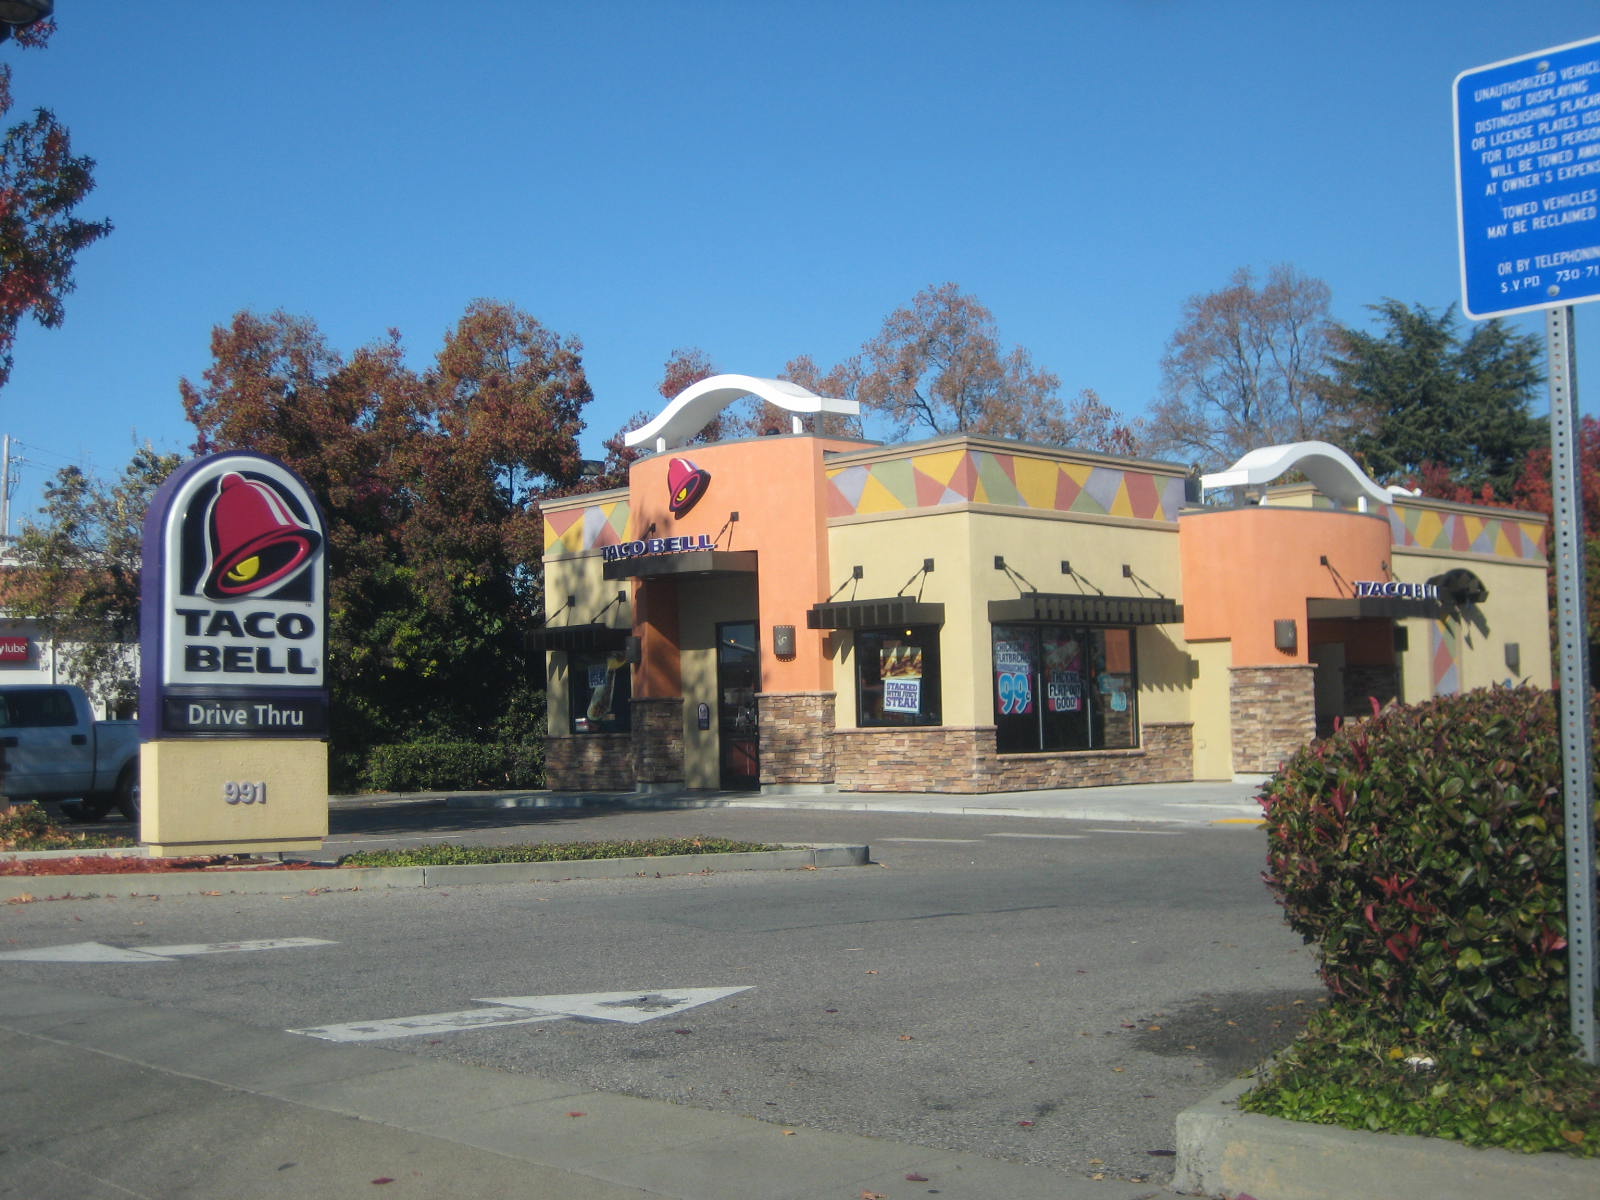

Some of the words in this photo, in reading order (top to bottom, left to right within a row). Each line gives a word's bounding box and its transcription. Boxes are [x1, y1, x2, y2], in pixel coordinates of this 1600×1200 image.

[1474, 71, 1556, 102] UNAUTHORIZED
[1501, 96, 1522, 112] NOT
[1525, 80, 1589, 106] DISPLAYING
[1471, 137, 1487, 151] OR
[1490, 125, 1534, 147] LICENSE
[1537, 115, 1578, 136] PLATES
[1475, 104, 1556, 134] DISTINGUISHING
[1482, 149, 1502, 165] FOR
[1506, 136, 1557, 160] DISABLED
[1490, 164, 1514, 178] WILL
[1518, 158, 1533, 173] BE
[1537, 149, 1574, 168] TOWED
[1485, 182, 1497, 196] AT
[1502, 170, 1553, 193] OWNER'S
[1502, 201, 1539, 219] TOWED
[1542, 189, 1598, 211] VEHICLES
[1487, 224, 1508, 239] MAY
[1512, 220, 1528, 234] BE
[1532, 206, 1598, 230] RECLAIMED
[1497, 262, 1512, 276] OR
[1516, 258, 1530, 272] BY
[600, 540, 646, 561] TACO
[648, 534, 717, 553] BELL
[1354, 581, 1412, 598] TACO
[175, 608, 316, 640] TACO
[184, 644, 318, 675] BELL
[886, 682, 918, 692] STACKED
[188, 703, 248, 725] Drive
[253, 704, 304, 726] Thru
[886, 697, 918, 709] STEAK
[223, 781, 267, 805] 991
